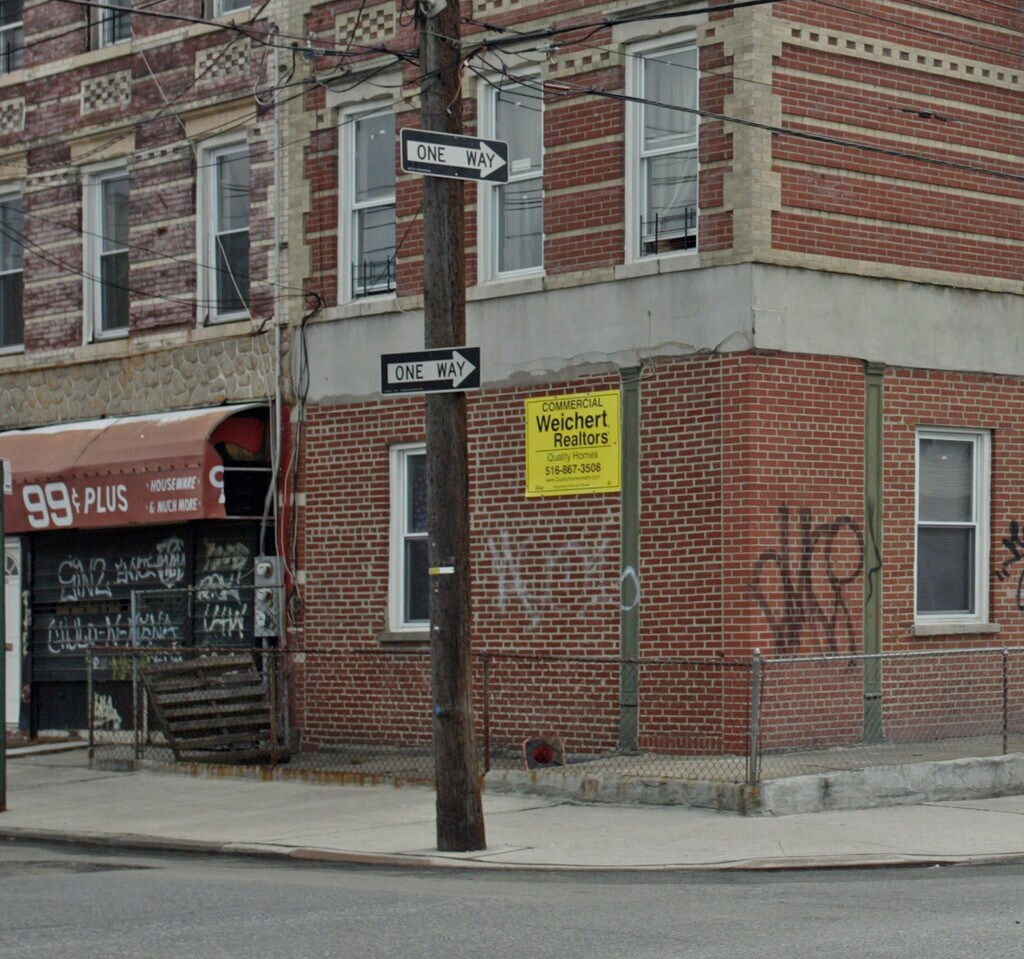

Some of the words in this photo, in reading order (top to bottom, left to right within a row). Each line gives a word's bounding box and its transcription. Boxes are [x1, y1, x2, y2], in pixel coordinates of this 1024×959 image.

[417, 144, 446, 163] ONE
[466, 150, 495, 168] WAY
[395, 364, 424, 381] ONE
[437, 361, 466, 378] WAY
[542, 398, 603, 412] COMMERCIAL
[547, 452, 571, 463] Quality
[572, 451, 599, 460] Homes
[545, 463, 601, 476] 516-867-3508
[150, 476, 197, 492] HOUSEWARE
[84, 484, 129, 514] PLUS
[149, 501, 155, 514] &
[157, 499, 177, 513] MUCH
[178, 497, 198, 512] MORE
